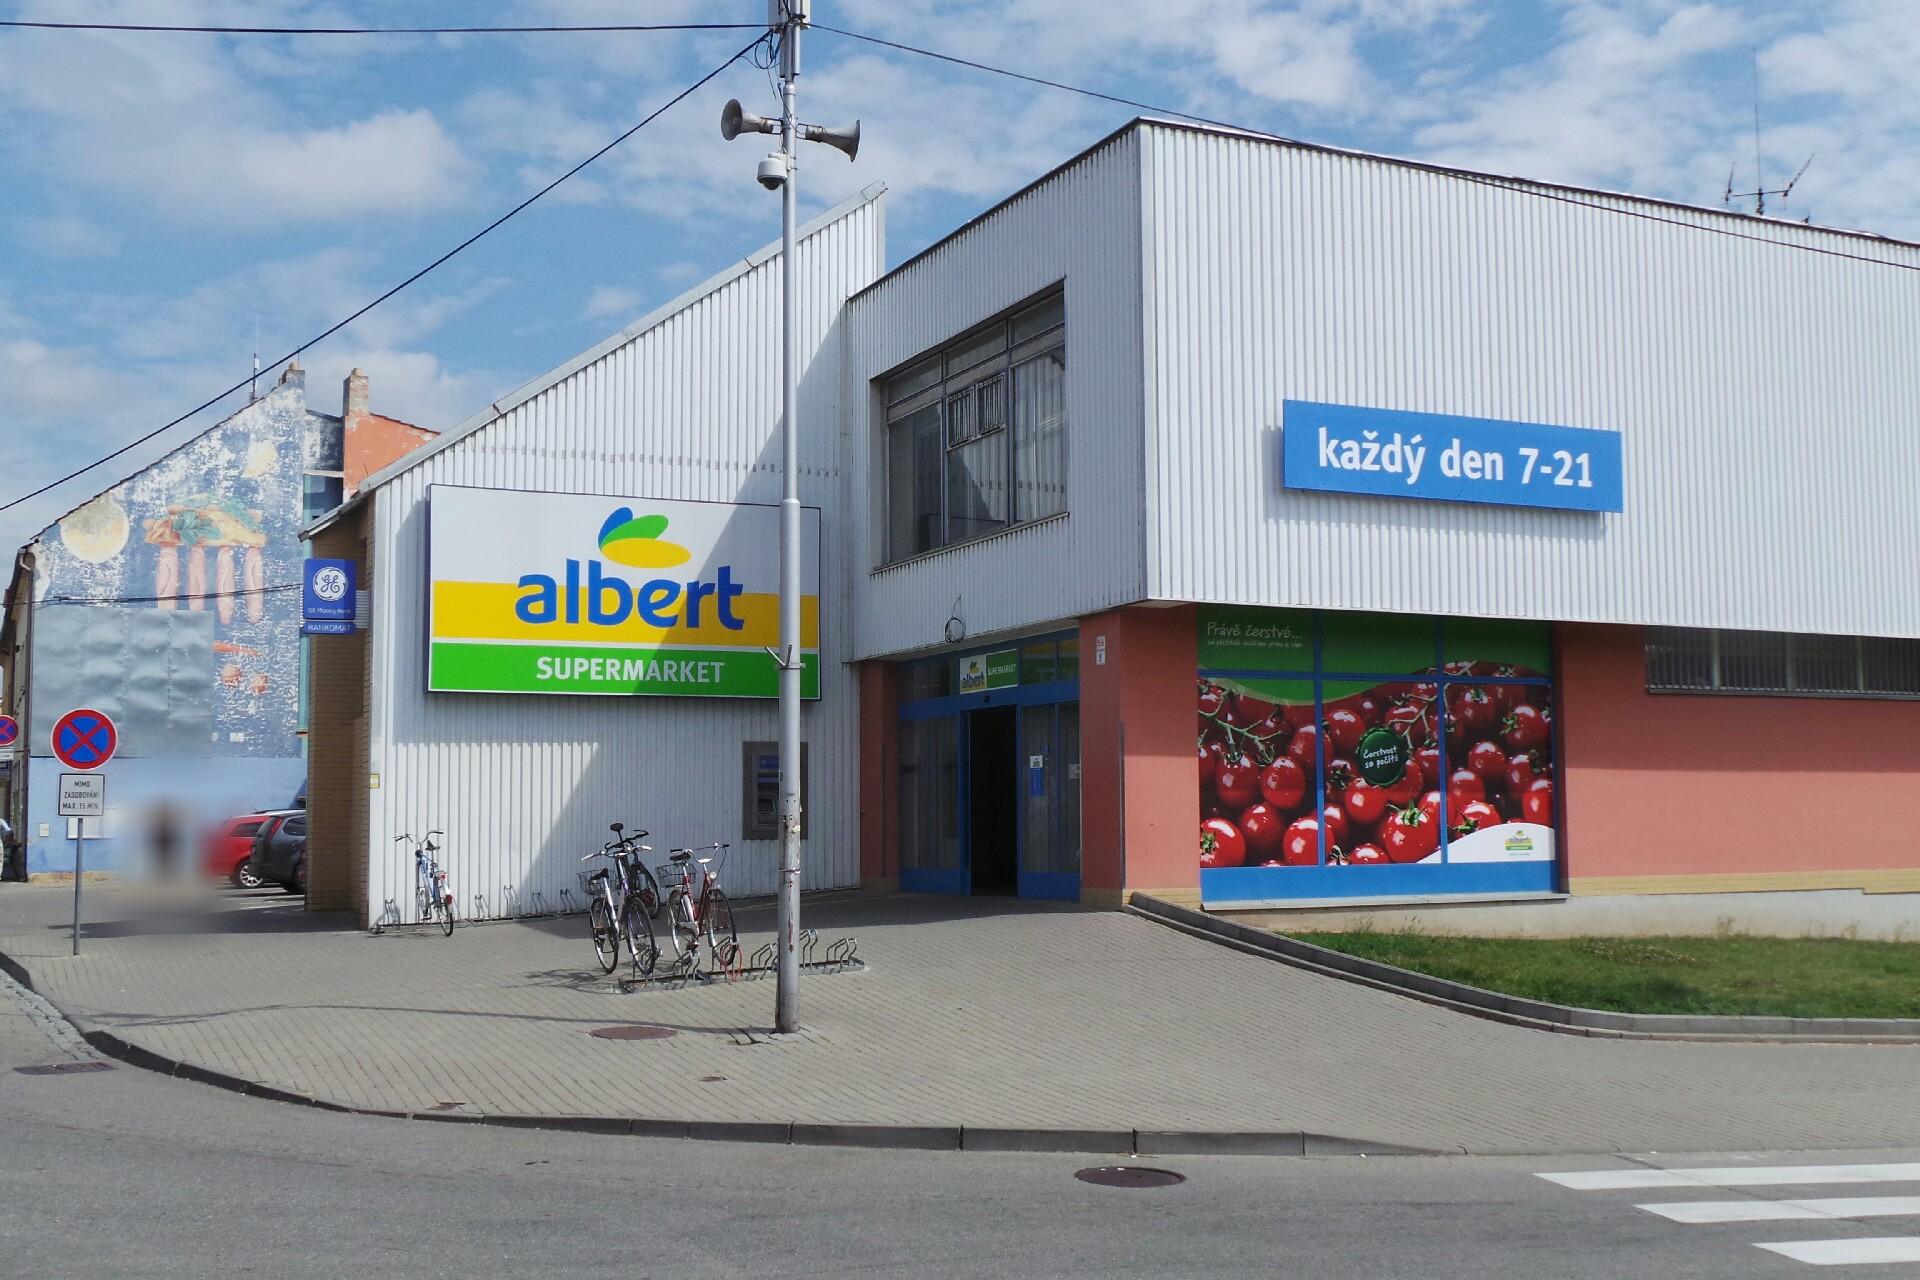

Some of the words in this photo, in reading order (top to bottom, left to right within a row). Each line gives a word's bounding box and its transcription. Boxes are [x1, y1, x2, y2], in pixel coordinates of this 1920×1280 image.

[1318, 427, 1426, 485] každý
[1440, 438, 1504, 481] den
[1519, 447, 1593, 488] 7-21
[515, 558, 745, 630] albert
[308, 624, 351, 632] BANKOMAT
[1207, 621, 1241, 637] Právě
[536, 656, 725, 684] SUPERMARKET
[987, 663, 1017, 676] SUPERMARKET
[962, 671, 985, 689] albert
